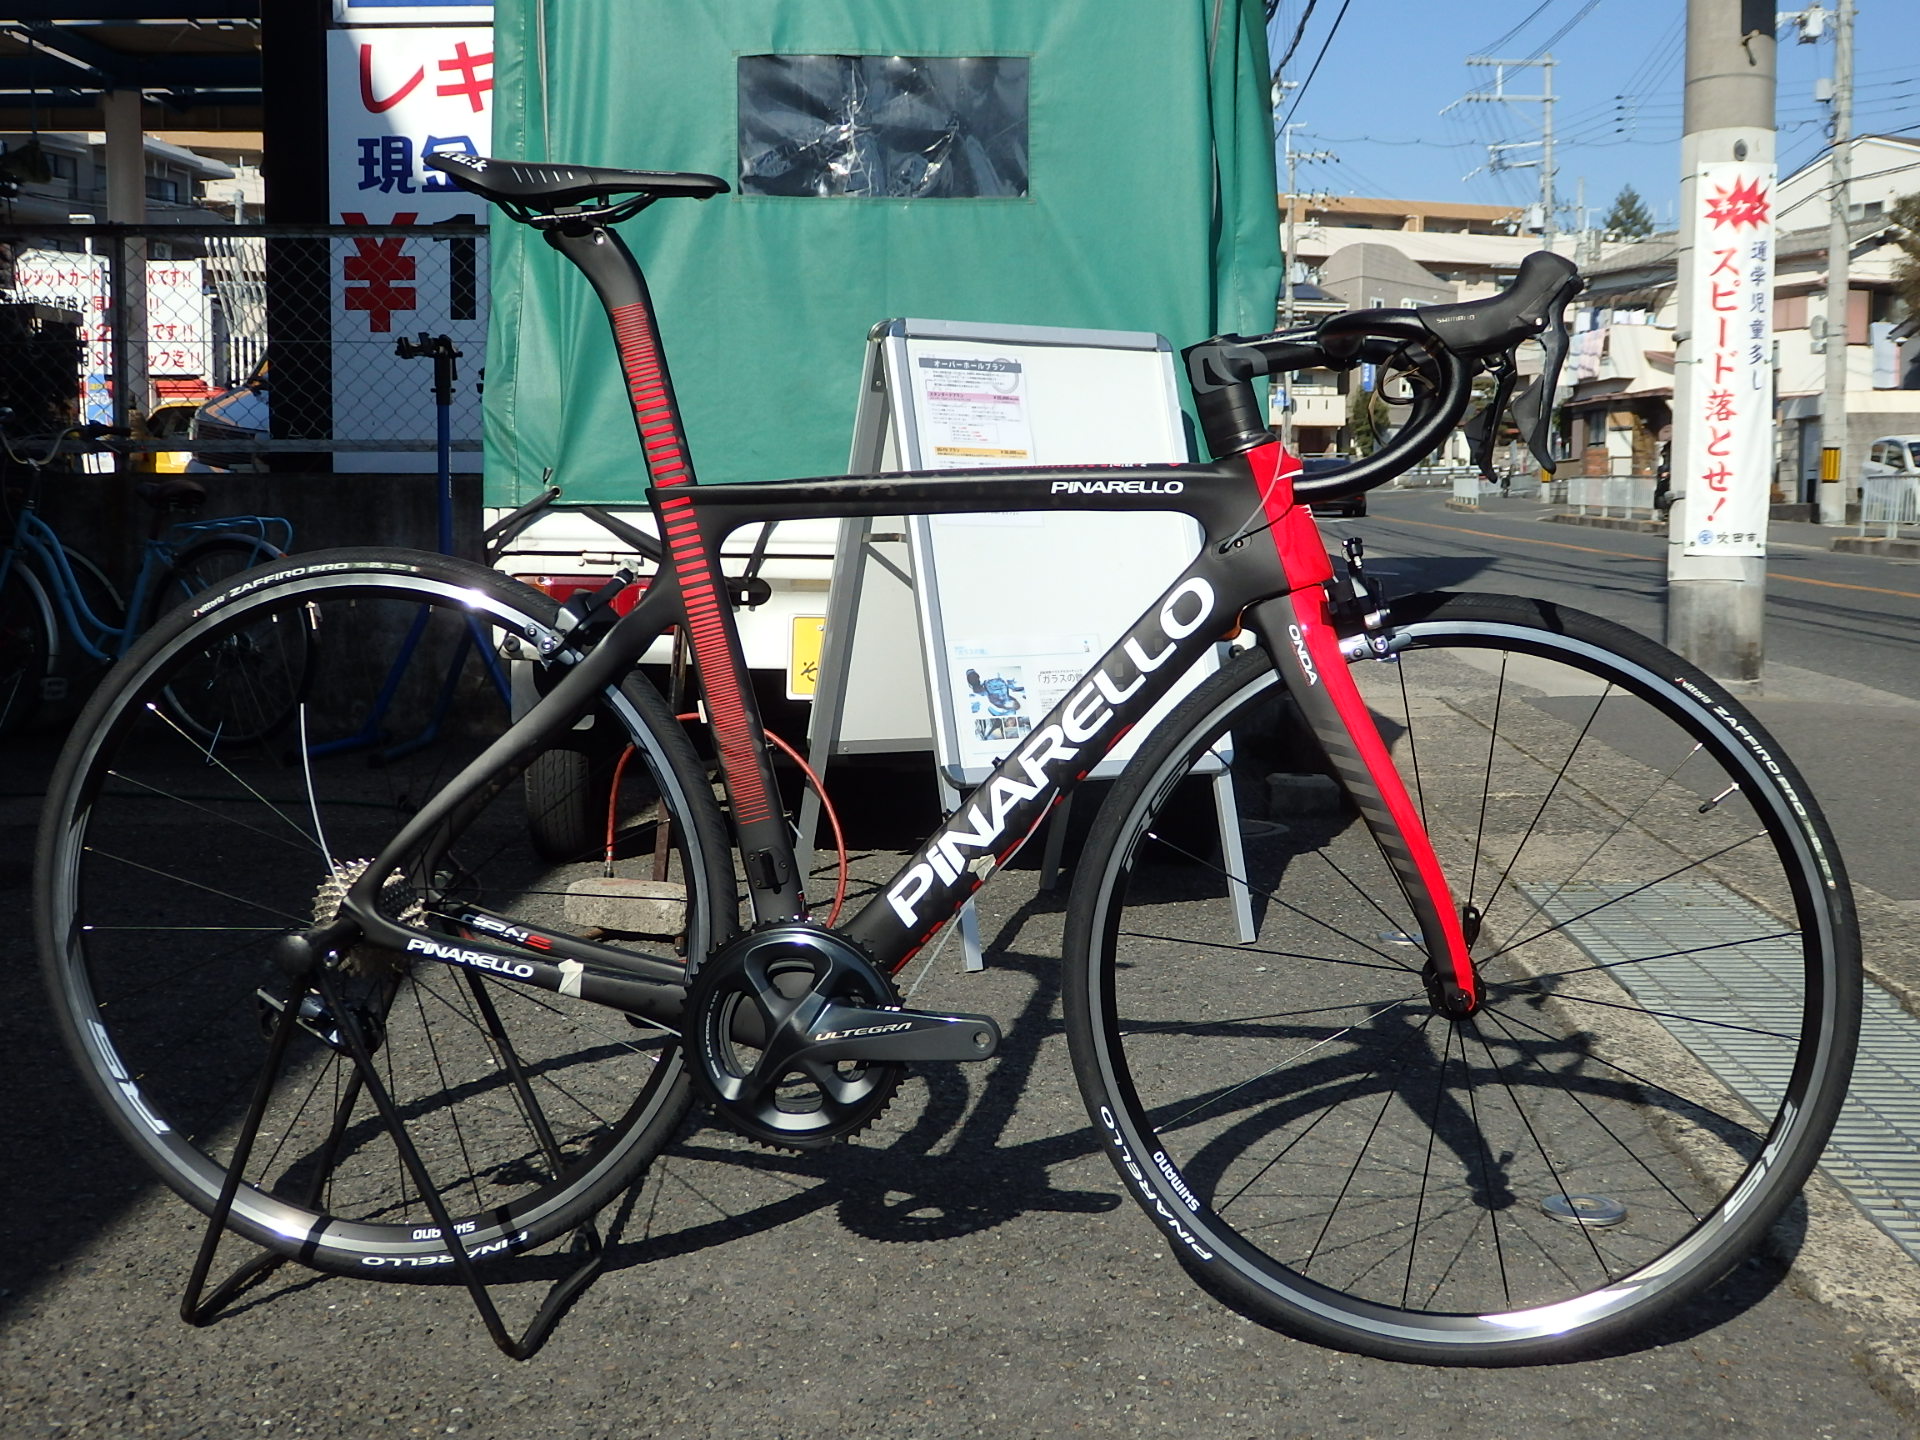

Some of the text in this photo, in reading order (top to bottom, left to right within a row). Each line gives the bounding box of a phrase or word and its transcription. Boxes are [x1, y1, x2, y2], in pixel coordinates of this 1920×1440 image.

[1716, 199, 1765, 215] キケン
[1749, 240, 1768, 391] 通学児童多し
[1050, 480, 1184, 494] PINARELLO
[229, 567, 306, 598] ZAFFIRO
[307, 562, 349, 574] PRO
[1288, 624, 1318, 686] ONDA
[886, 577, 1215, 929] PINARELLO
[1713, 705, 1780, 775] ZAFFIRO
[1777, 774, 1807, 816] PRO
[406, 938, 534, 978] PINARELLO
[815, 1021, 912, 1042] ULTEGRA
[1100, 1105, 1213, 1260] PINARELLO
[1153, 1150, 1200, 1211] SHIMANO
